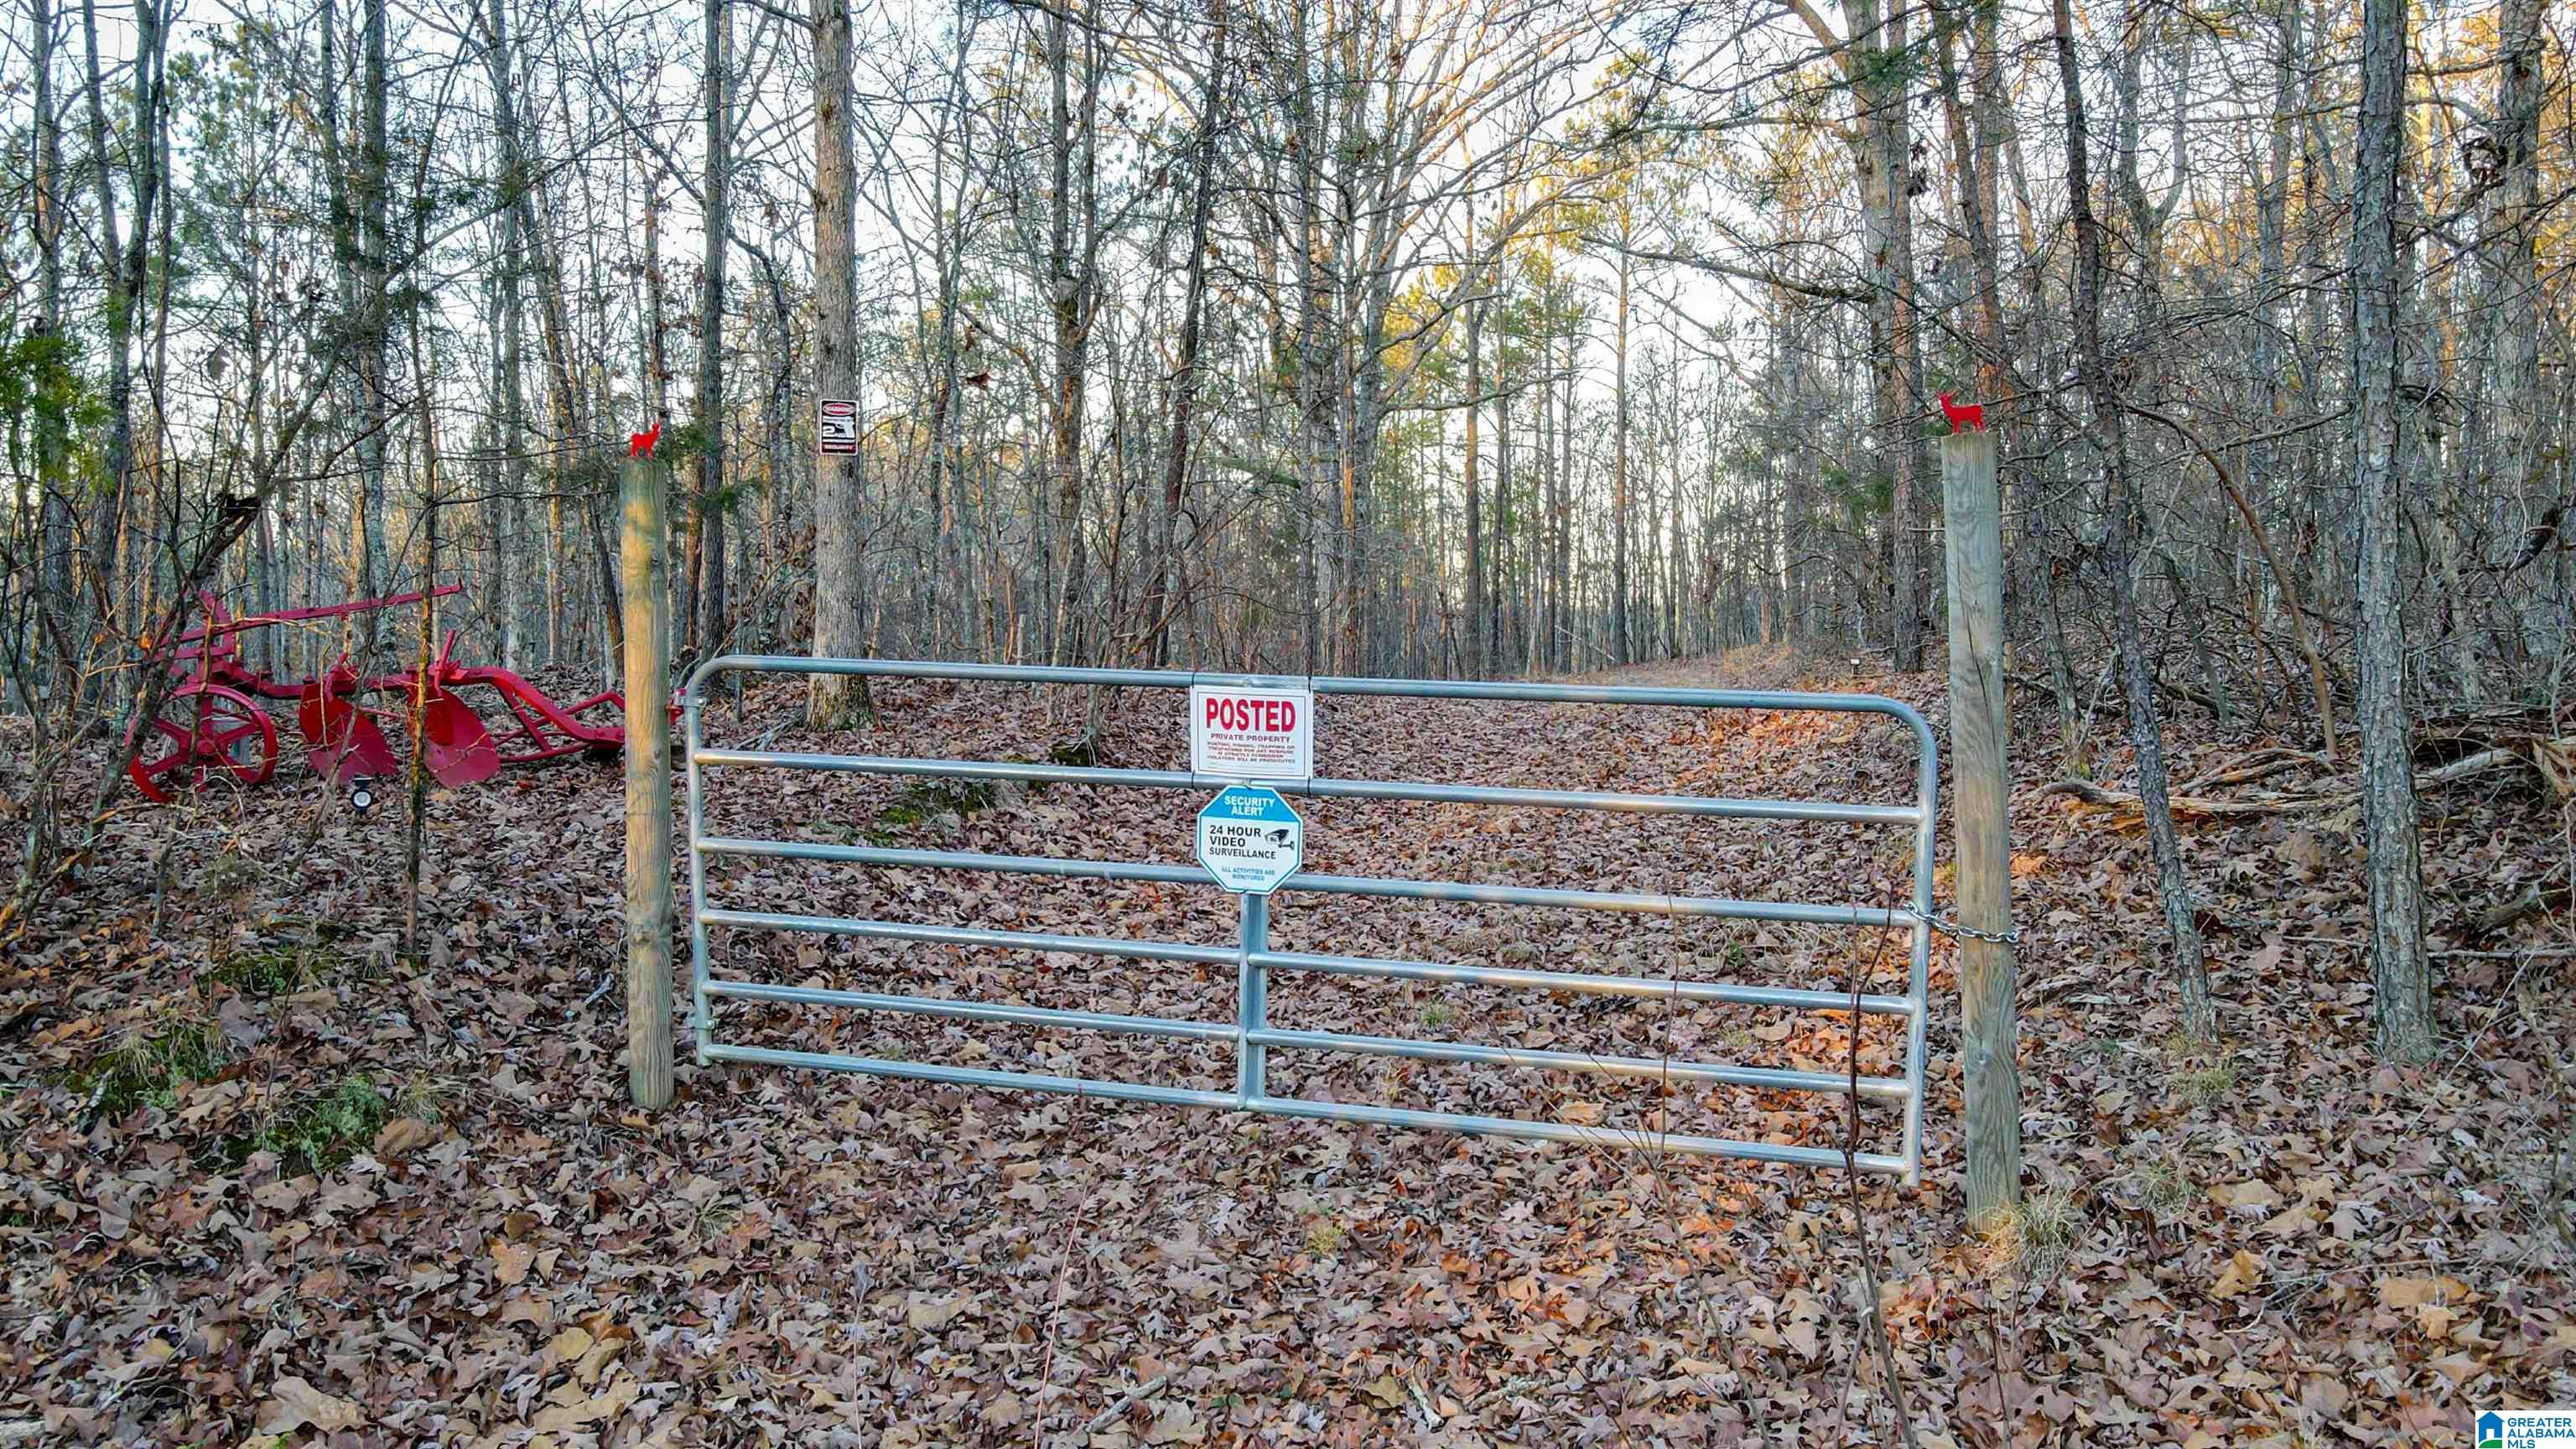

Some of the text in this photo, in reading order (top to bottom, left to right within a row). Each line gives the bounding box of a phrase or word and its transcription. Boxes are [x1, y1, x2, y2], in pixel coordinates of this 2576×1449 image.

[1206, 698, 1296, 732] POSTED
[1211, 733, 1291, 743] PRIVATE PROPERTY
[1224, 796, 1275, 808] SECURITY
[1231, 805, 1264, 816] ALERT
[1209, 825, 1261, 837] 24 HOUR
[1209, 836, 1246, 847] VIDEO
[1209, 847, 1276, 860] SURVEILLANCE
